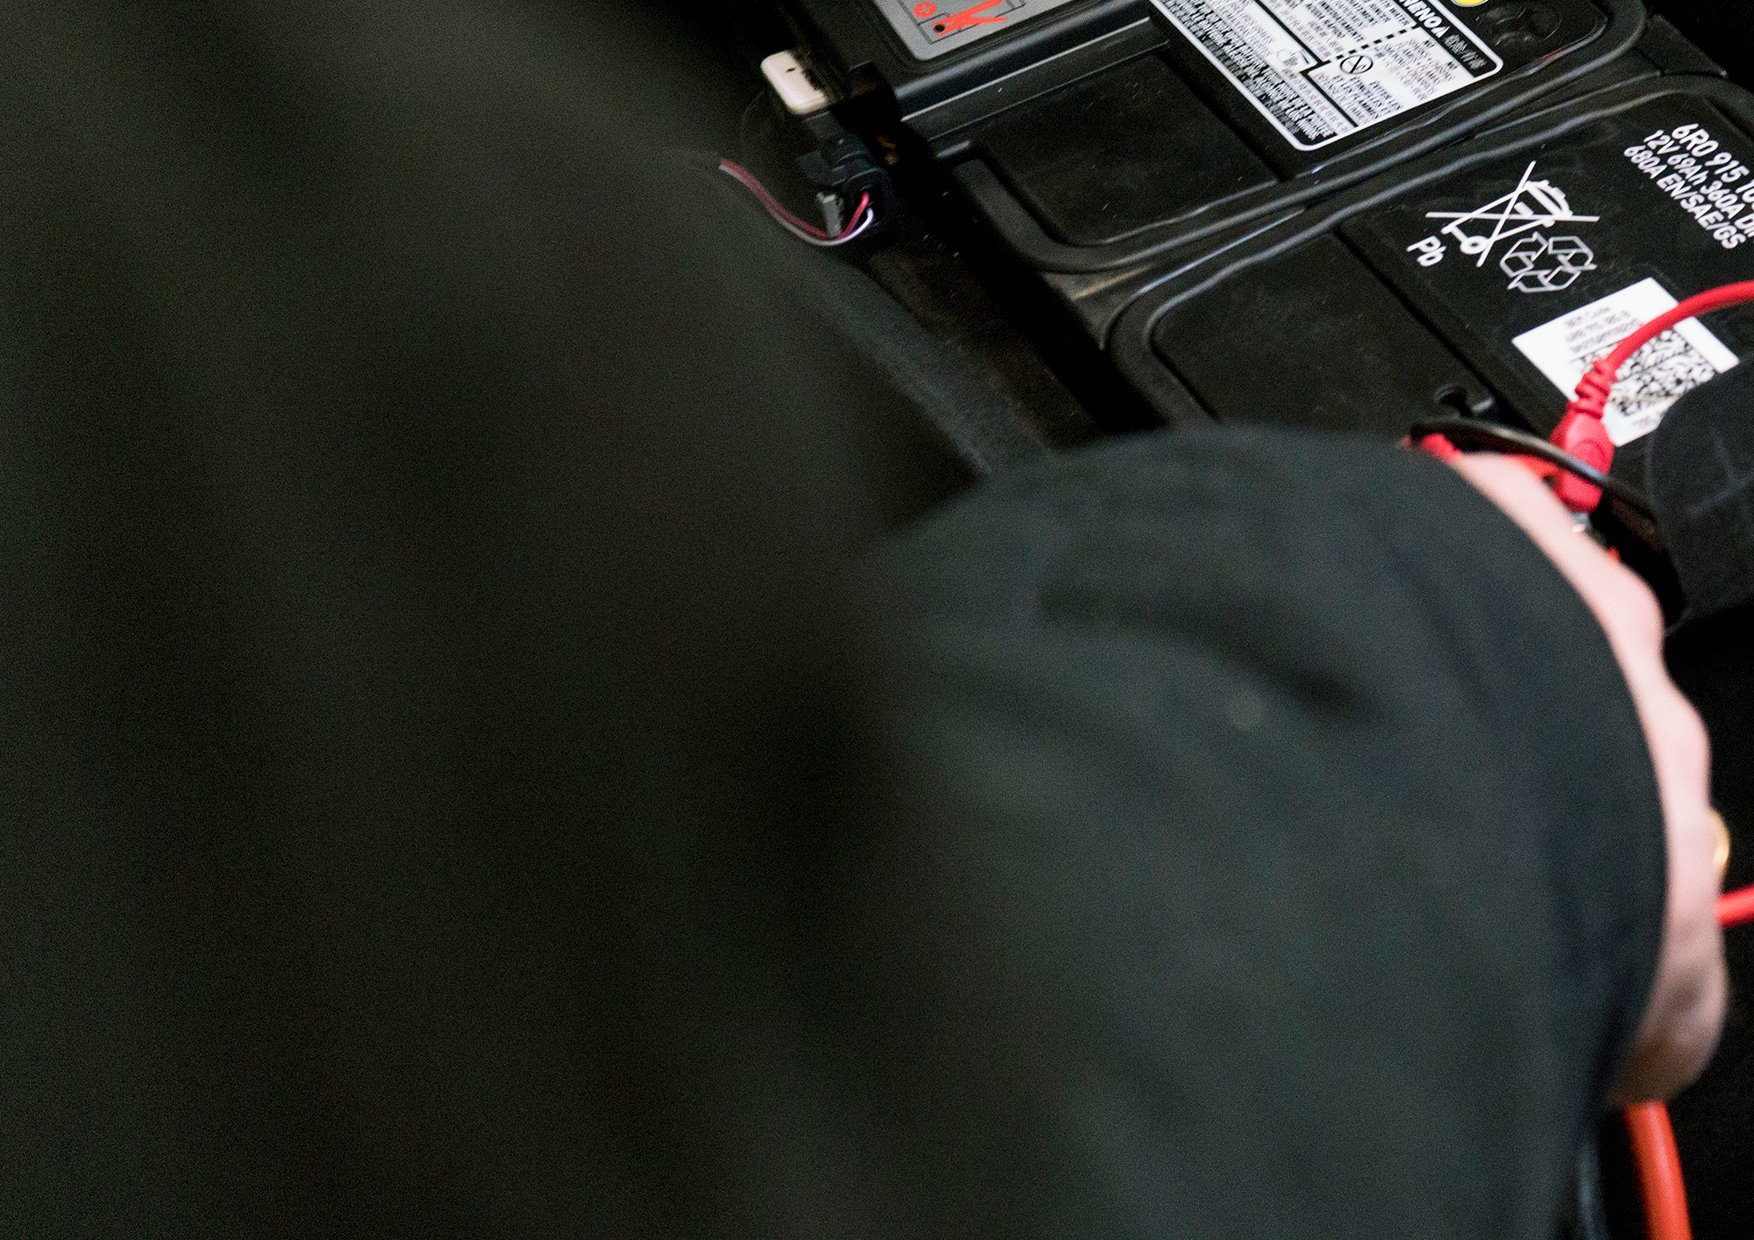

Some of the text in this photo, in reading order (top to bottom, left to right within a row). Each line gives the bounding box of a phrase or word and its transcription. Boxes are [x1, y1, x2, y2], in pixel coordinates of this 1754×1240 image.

[1623, 146, 1747, 249] 680A EN/SAE/GS
[1644, 130, 1680, 156] 12V
[1667, 152, 1709, 186] 69Ah
[1700, 180, 1745, 219] 360A
[1705, 153, 1749, 182] 915
[1406, 235, 1447, 267] Pb
